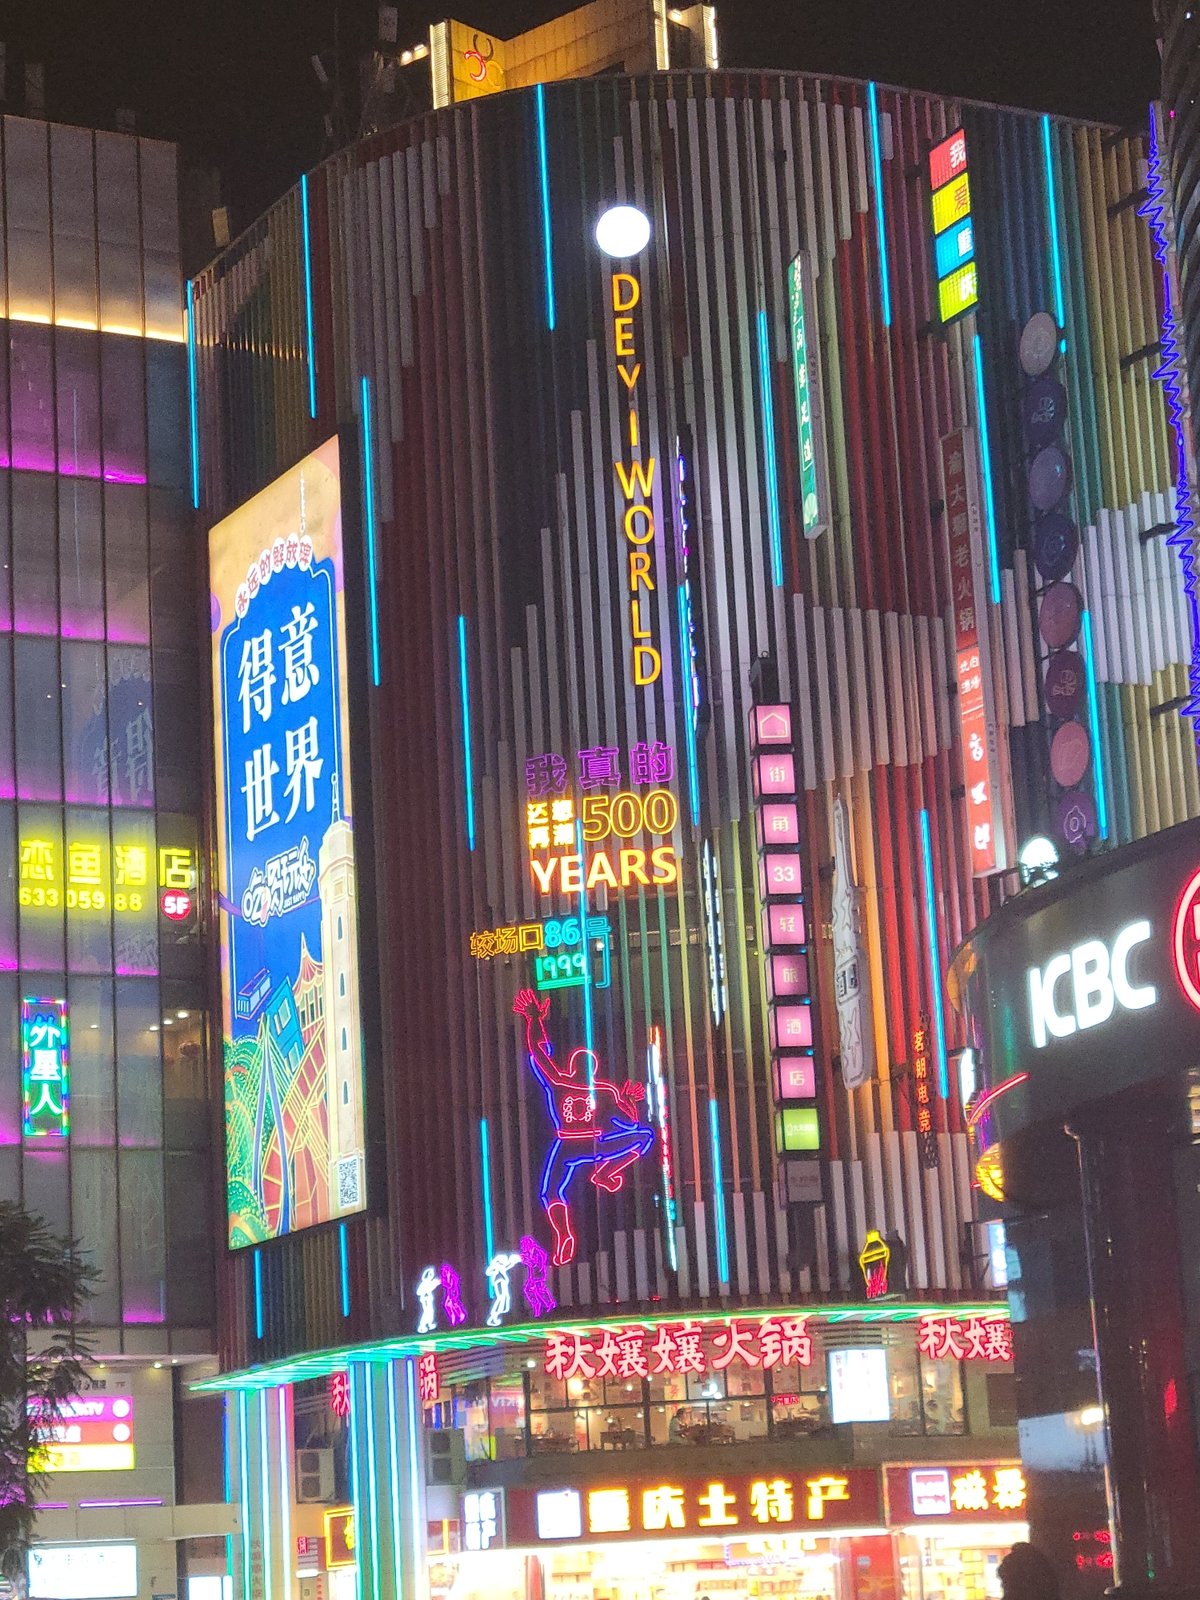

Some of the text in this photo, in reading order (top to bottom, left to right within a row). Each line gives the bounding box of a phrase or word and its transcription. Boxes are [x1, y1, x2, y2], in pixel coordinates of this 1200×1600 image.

[615, 457, 661, 687] WORLD
[238, 601, 320, 733] 得意
[241, 716, 324, 842] 世界
[526, 742, 674, 795] 我真的
[582, 790, 678, 841] 500
[531, 847, 678, 893] YEARS
[164, 896, 190, 914] 5F
[535, 953, 589, 981] 1999
[1029, 920, 1156, 1048] ICBC
[30, 1024, 62, 1115] 外星人
[588, 1477, 850, 1533] 重庆土特产
